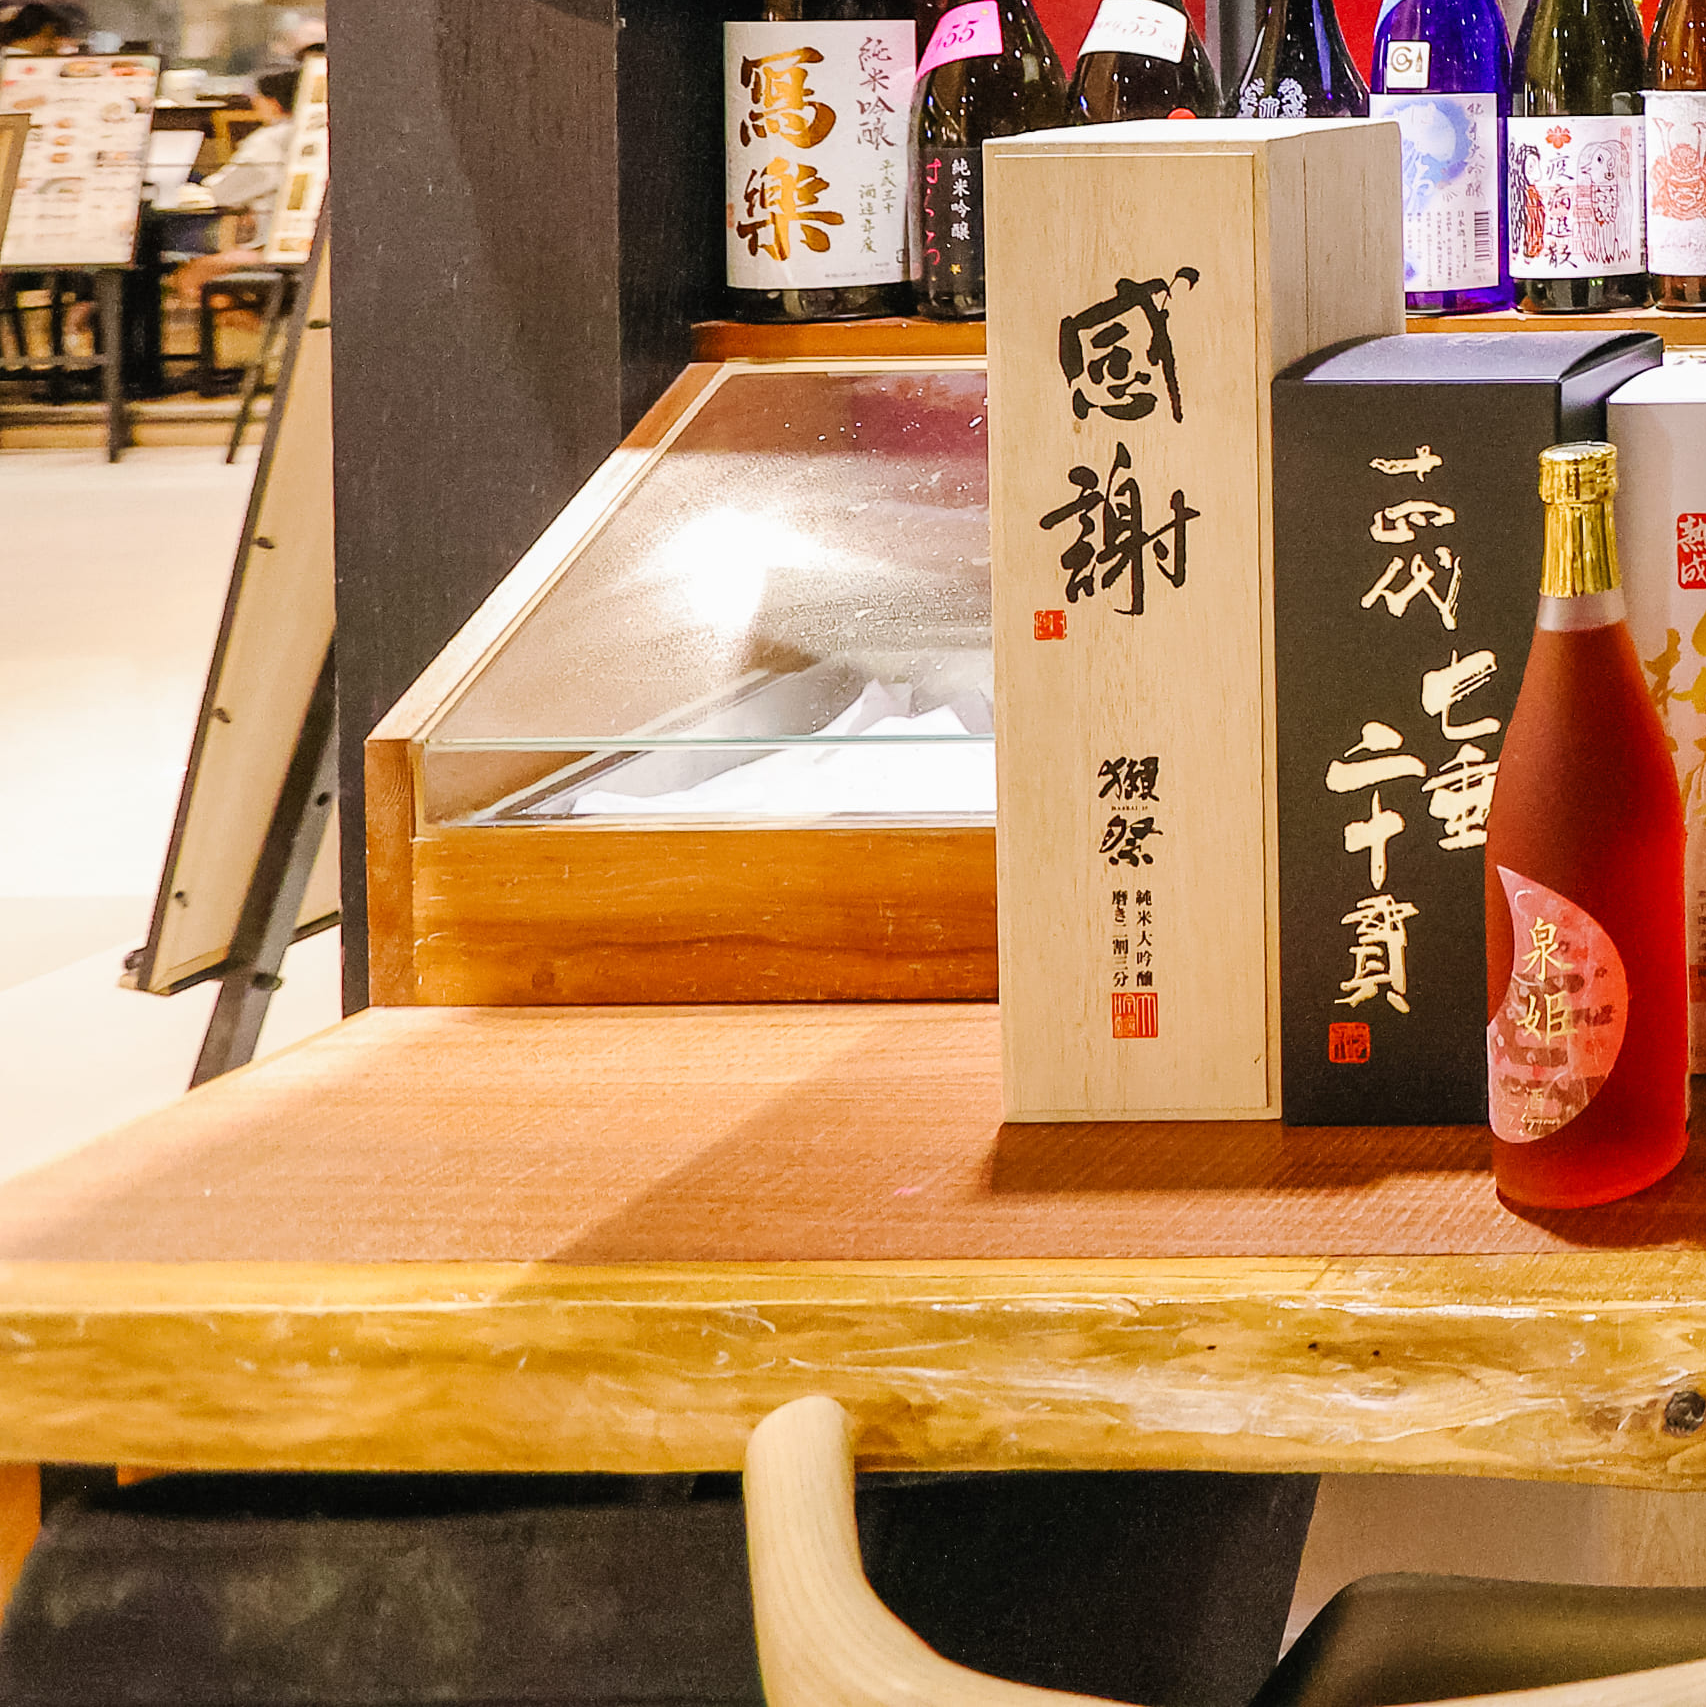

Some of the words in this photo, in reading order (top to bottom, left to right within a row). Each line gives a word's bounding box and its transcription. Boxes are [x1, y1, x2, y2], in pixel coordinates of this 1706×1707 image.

[856, 36, 896, 151] 純米吟醸
[950, 157, 971, 241] 純米吟醸
[1546, 152, 1578, 269] 疫病退散
[1039, 266, 1201, 616] 感謝
[1361, 445, 1463, 630] 十四代
[1098, 756, 1163, 867] 獺祭
[1112, 889, 1129, 988] 磨き二割三分
[1135, 889, 1153, 987] 純米大吟醸
[1516, 916, 1578, 1045] 泉姫
